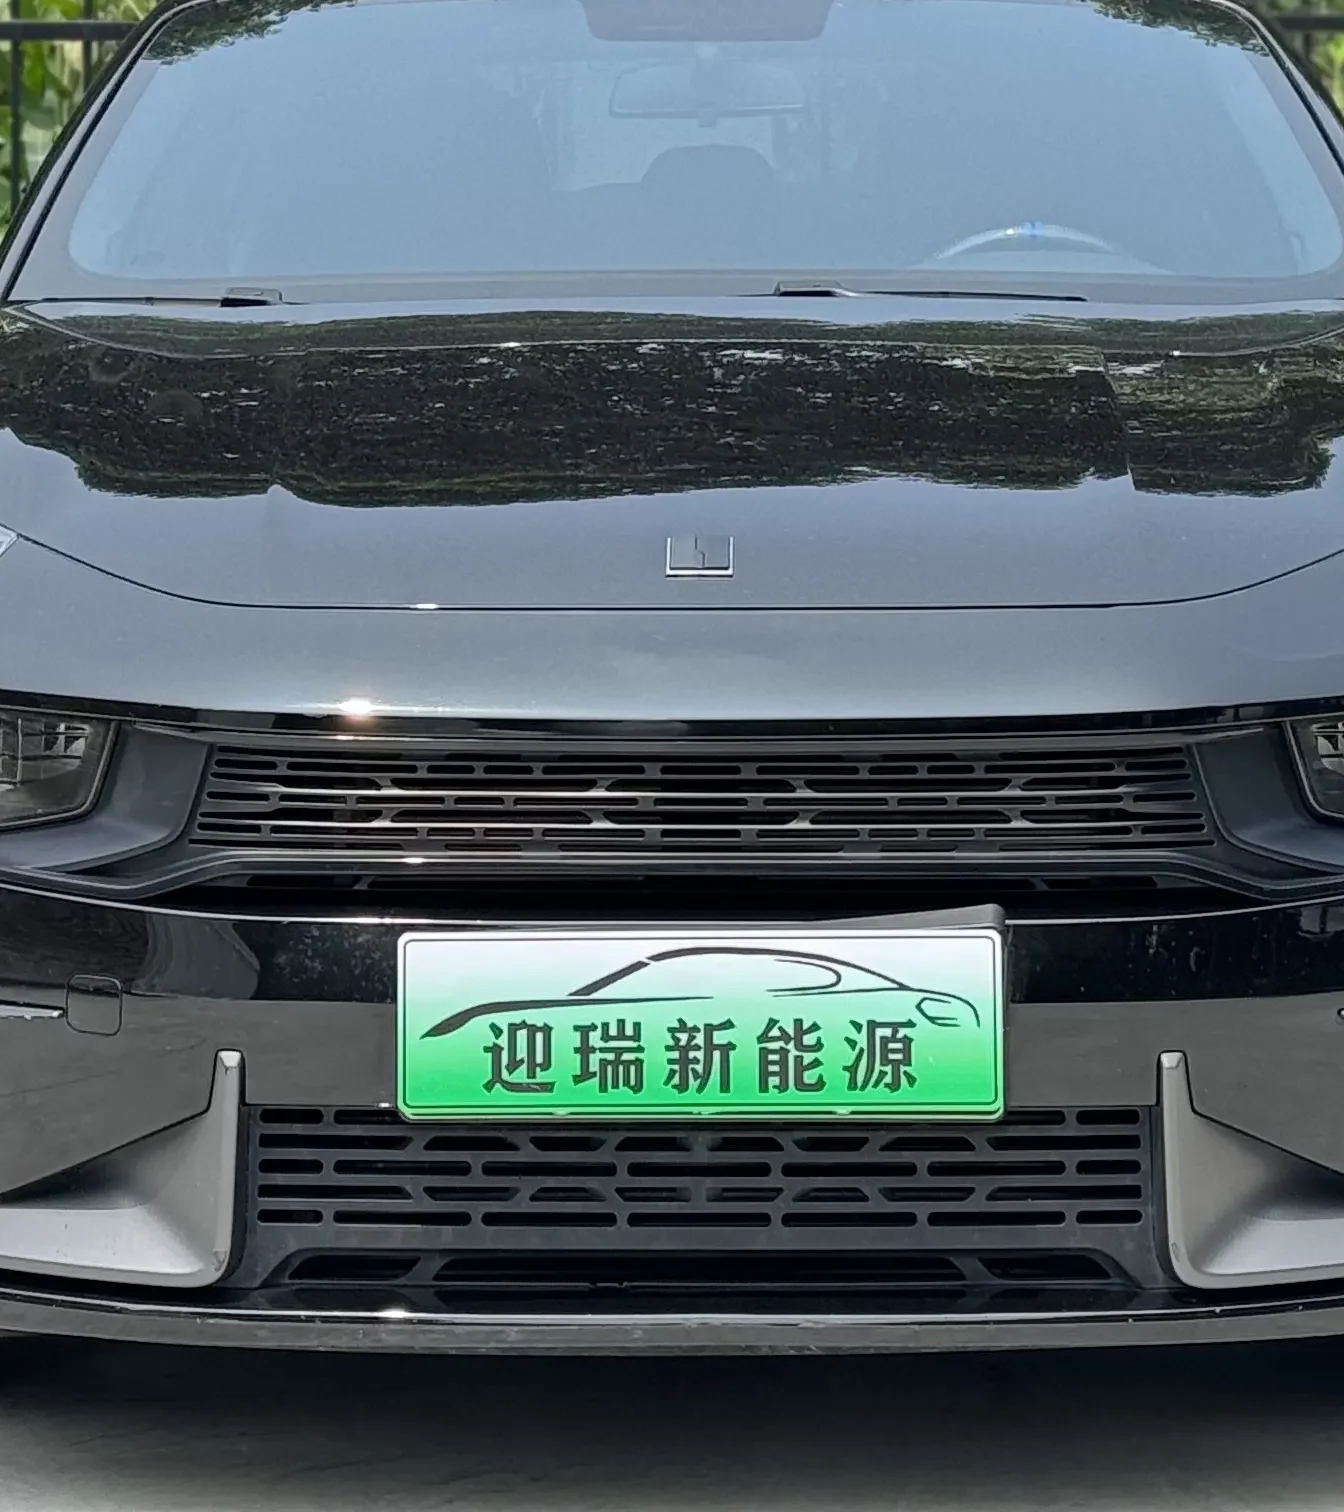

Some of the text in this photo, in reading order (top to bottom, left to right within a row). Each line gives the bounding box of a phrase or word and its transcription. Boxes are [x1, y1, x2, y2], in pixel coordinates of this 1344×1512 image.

[482, 1018, 918, 1095] 迎瑞新能源
